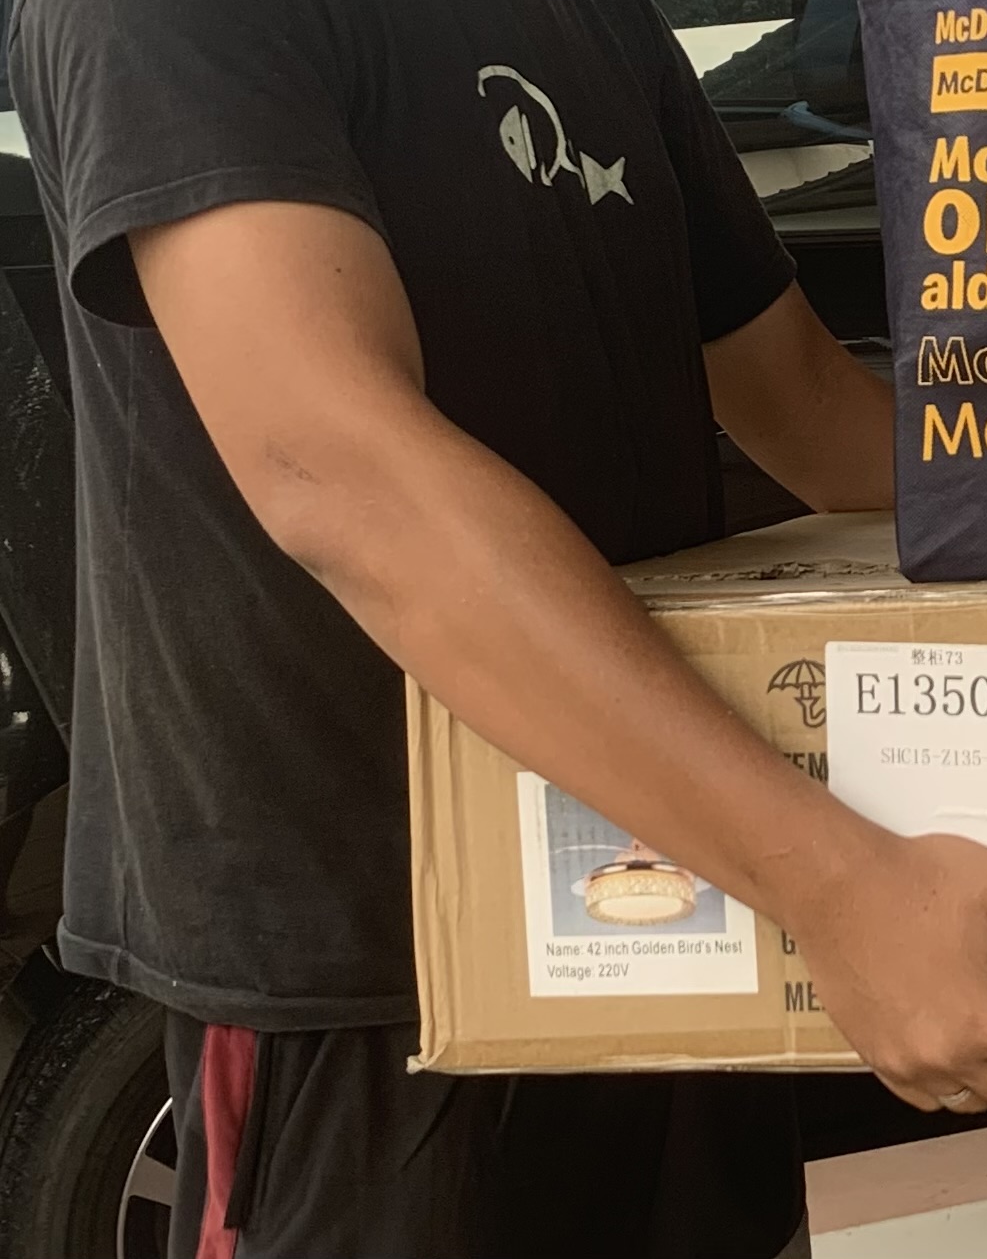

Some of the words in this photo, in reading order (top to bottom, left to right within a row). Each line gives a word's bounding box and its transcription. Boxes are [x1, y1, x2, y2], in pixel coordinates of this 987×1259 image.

[546, 943, 583, 957] Name:
[587, 942, 601, 956] 42
[604, 941, 629, 955] inch
[631, 941, 675, 955] Golden
[678, 939, 711, 954] Bird's
[715, 939, 743, 954] Nest
[547, 963, 594, 980] Voltage:
[598, 963, 629, 977] 220V
